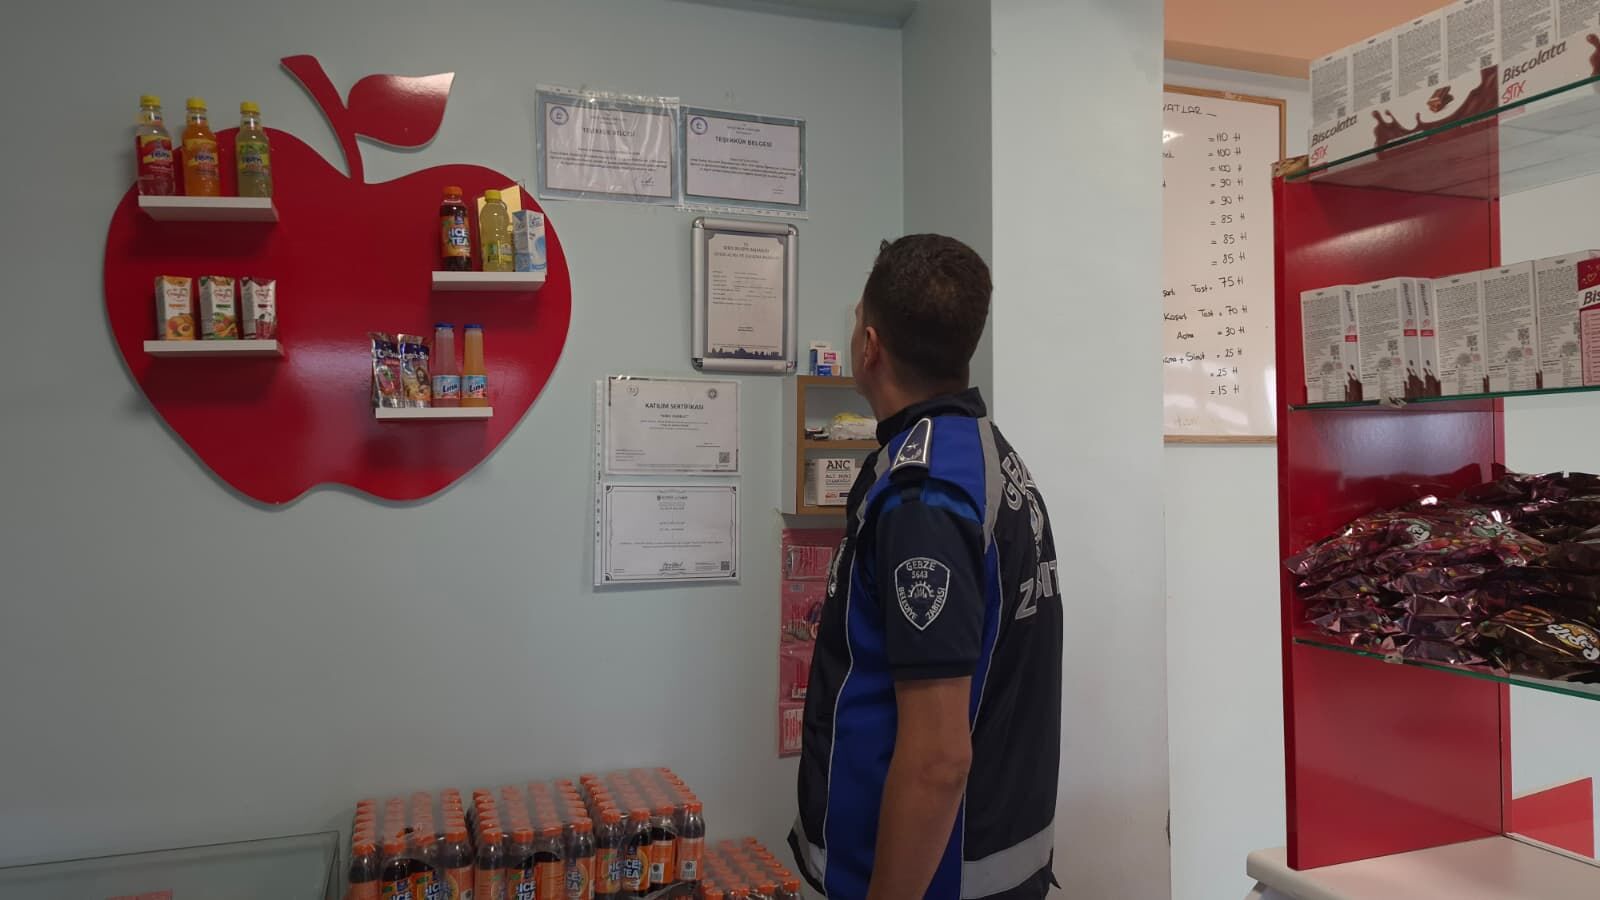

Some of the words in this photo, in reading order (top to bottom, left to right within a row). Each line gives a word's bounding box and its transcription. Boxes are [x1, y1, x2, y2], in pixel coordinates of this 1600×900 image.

[1502, 41, 1567, 85] Biscolata
[1311, 113, 1358, 148] Biscolata
[1216, 132, 1229, 142] 110
[450, 227, 469, 237] ICE
[451, 236, 469, 246] TEA
[1223, 233, 1235, 245] 85
[1191, 284, 1208, 293] Tost
[1218, 275, 1234, 288] 75
[1197, 308, 1214, 317] Tost
[1225, 305, 1238, 316] 70
[1225, 326, 1236, 337] 30
[1185, 351, 1205, 362] Simit
[1216, 367, 1228, 377] 25
[1218, 385, 1228, 396] 15
[826, 459, 850, 470] ANC
[906, 560, 937, 571] GEBZE
[911, 570, 928, 579] 5643
